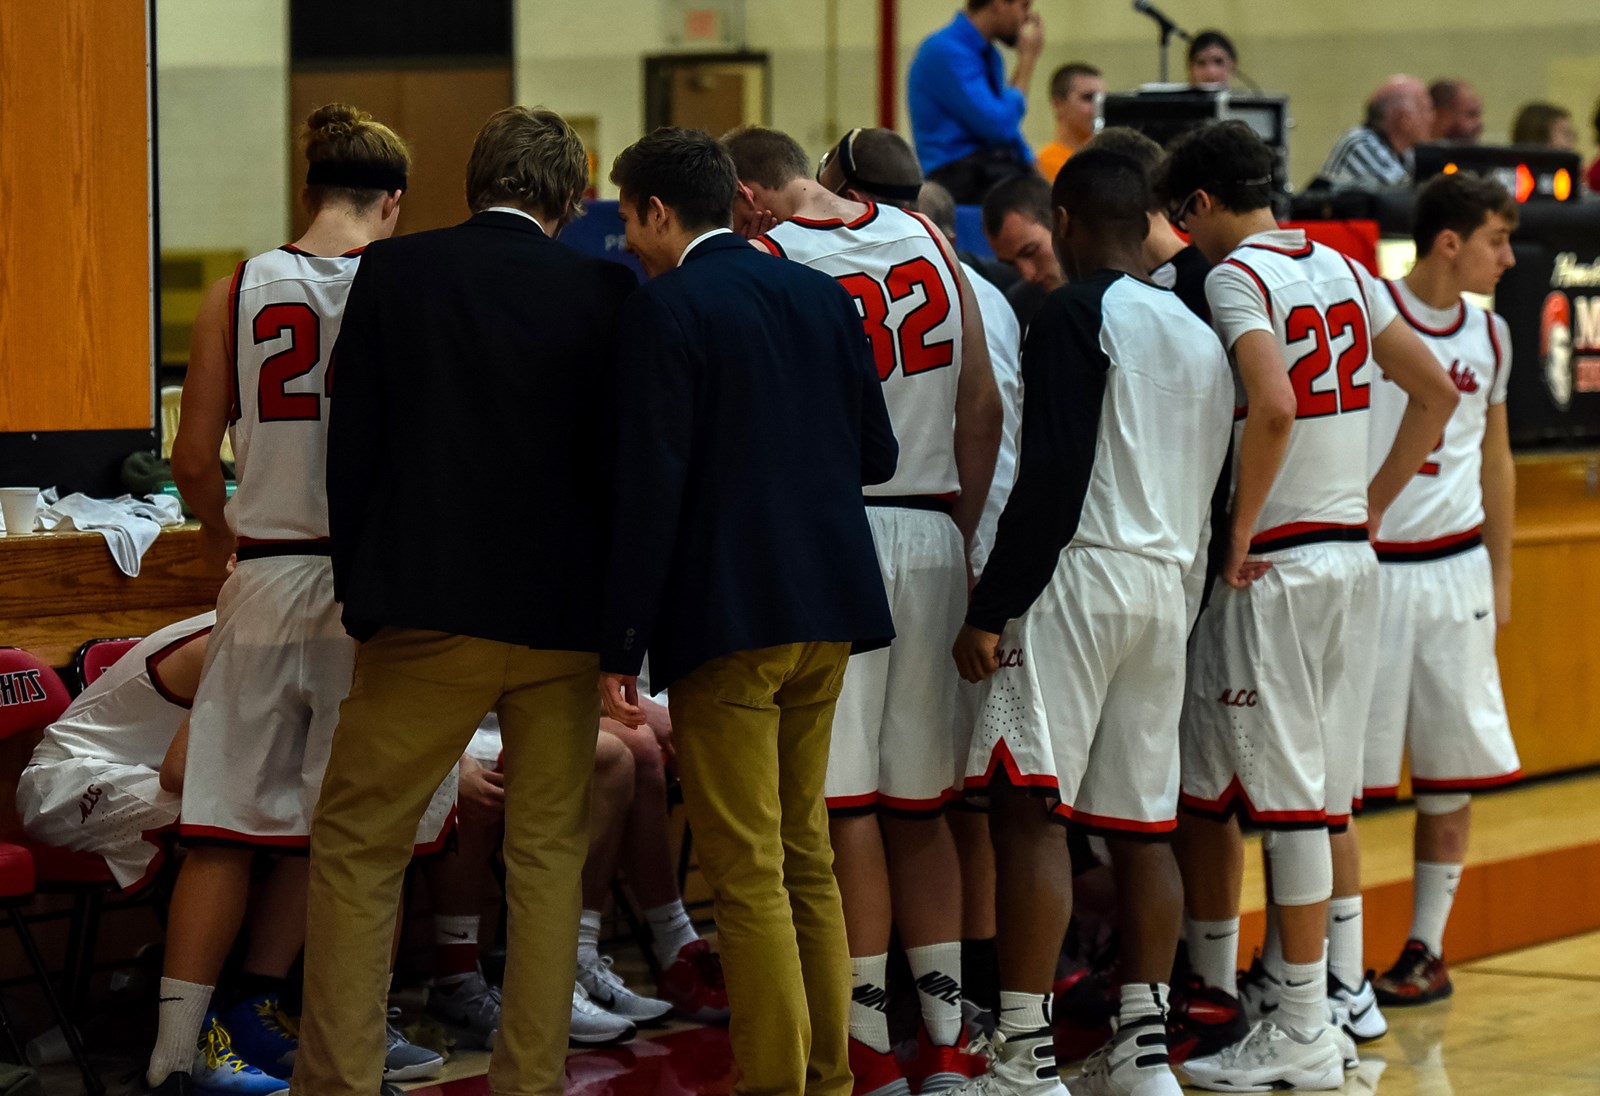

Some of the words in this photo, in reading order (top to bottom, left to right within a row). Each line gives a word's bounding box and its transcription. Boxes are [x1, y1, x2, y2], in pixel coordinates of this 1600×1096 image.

[252, 302, 335, 423] 2
[1285, 298, 1370, 420] 22
[0, 669, 47, 707] HTS
